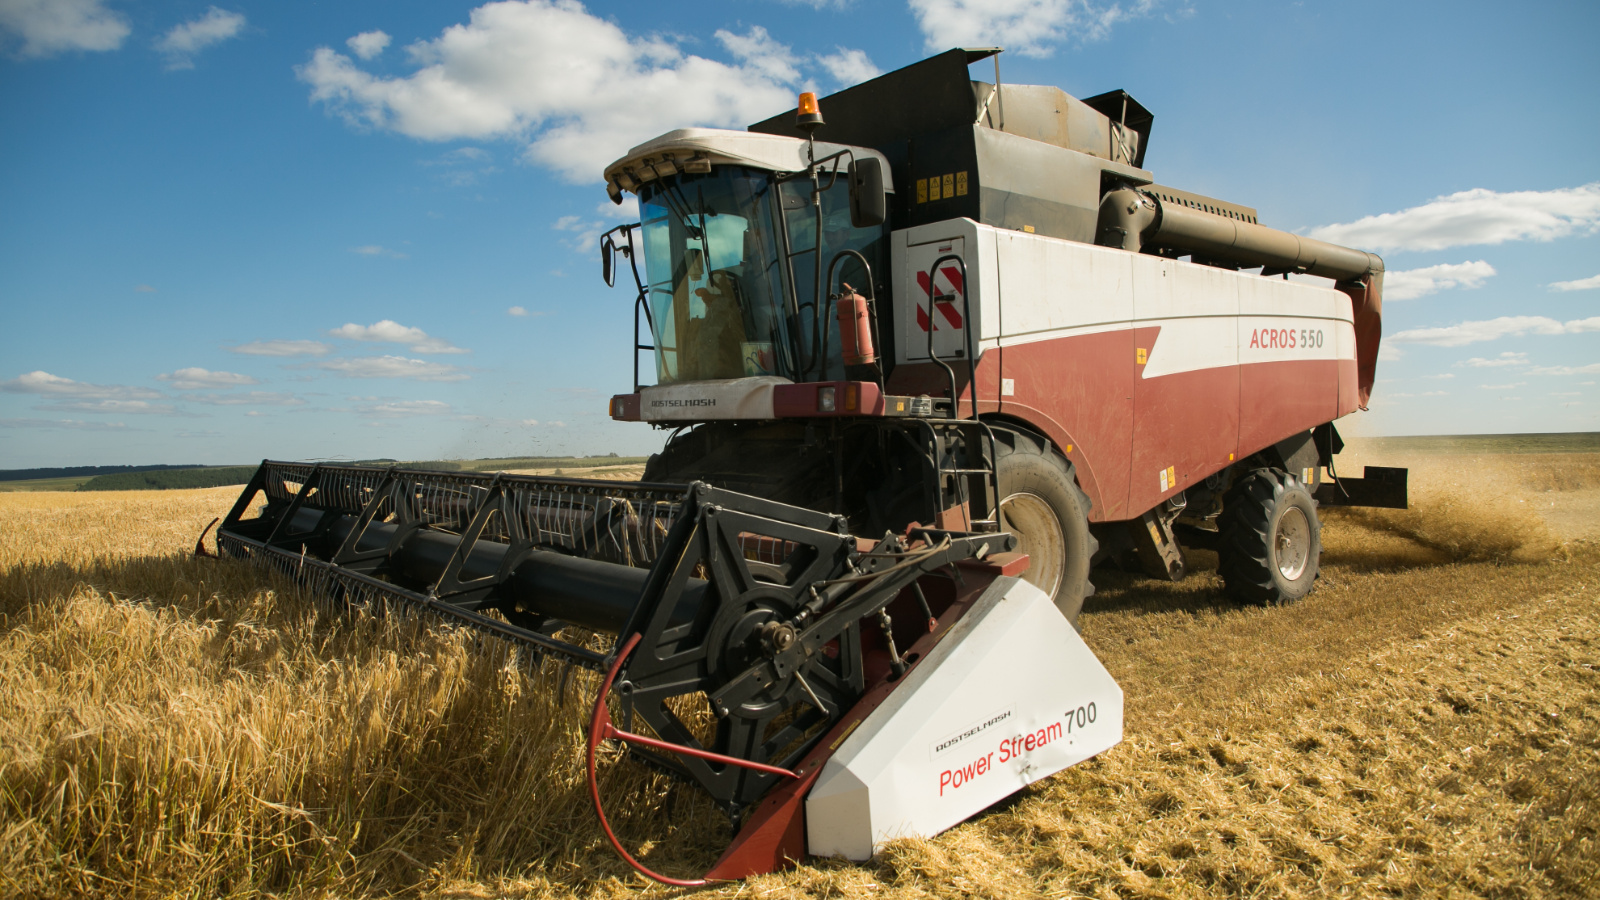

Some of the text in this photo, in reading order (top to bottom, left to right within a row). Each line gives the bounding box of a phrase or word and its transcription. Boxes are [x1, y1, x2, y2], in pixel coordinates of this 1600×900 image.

[1250, 328, 1324, 349] ACROS 550
[936, 710, 1011, 753] ROSTSELMASH
[939, 701, 1097, 797] Power Stream 700
